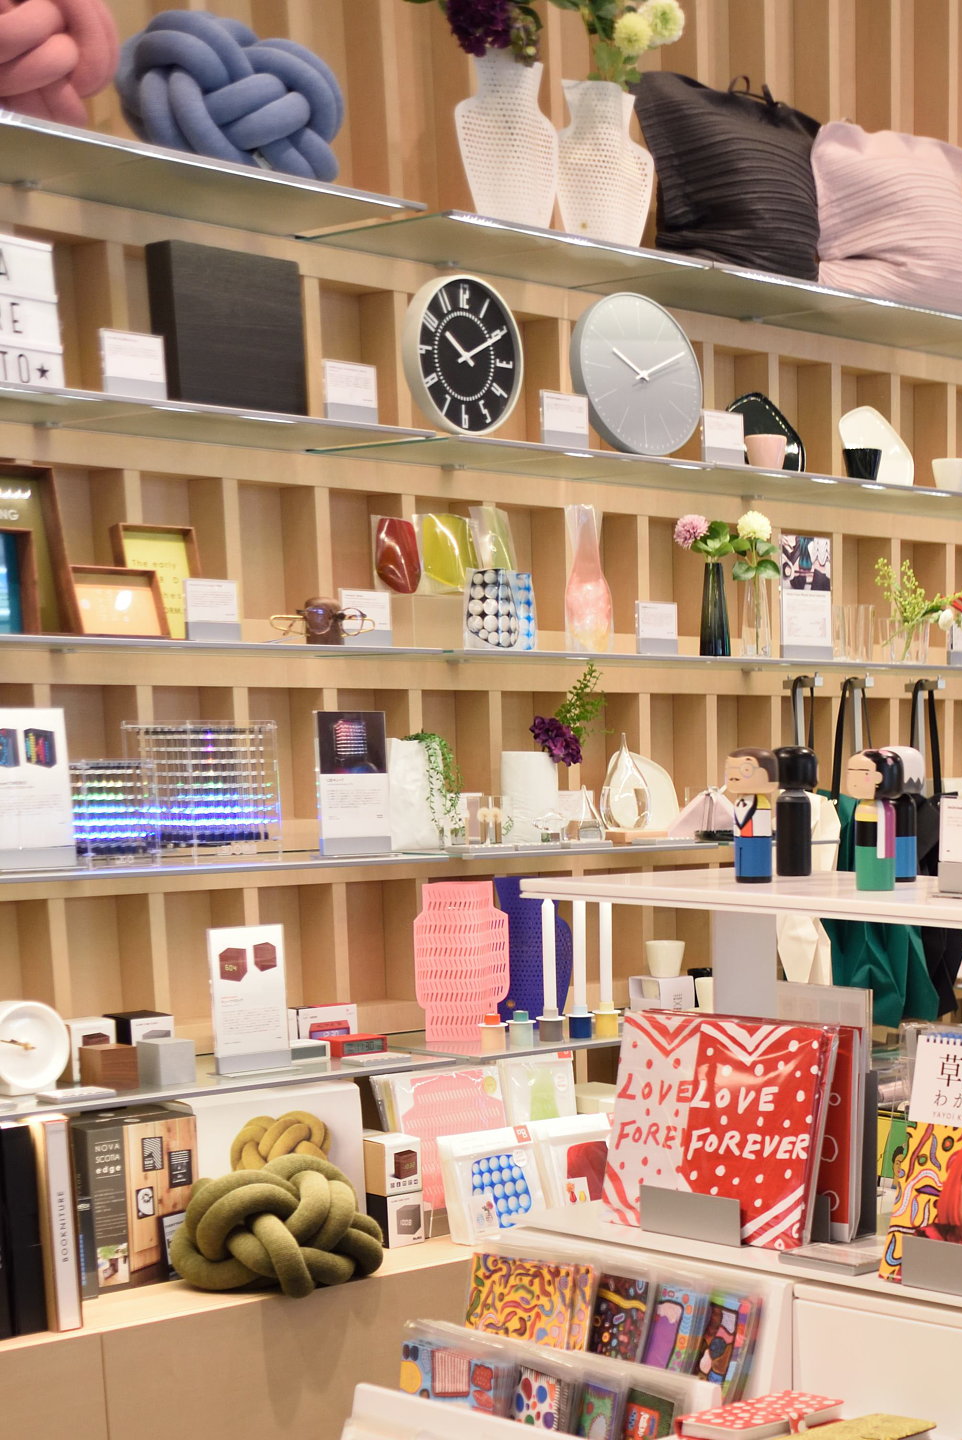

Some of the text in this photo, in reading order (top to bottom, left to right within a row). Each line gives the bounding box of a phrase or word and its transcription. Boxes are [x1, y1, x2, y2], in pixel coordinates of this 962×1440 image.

[460, 283, 470, 310] 12
[478, 399, 492, 424] 5
[617, 1073, 694, 1105] LOVE
[689, 1079, 780, 1115] LOVE
[932, 1111, 955, 1120] YAYOI
[94, 1143, 121, 1153] NOVA
[615, 1120, 686, 1150] FORE
[686, 1127, 811, 1161] FOREVER
[95, 1154, 121, 1164] SCOTIA
[95, 1164, 122, 1175] edge
[57, 1191, 69, 1263] BOOKNITURE
